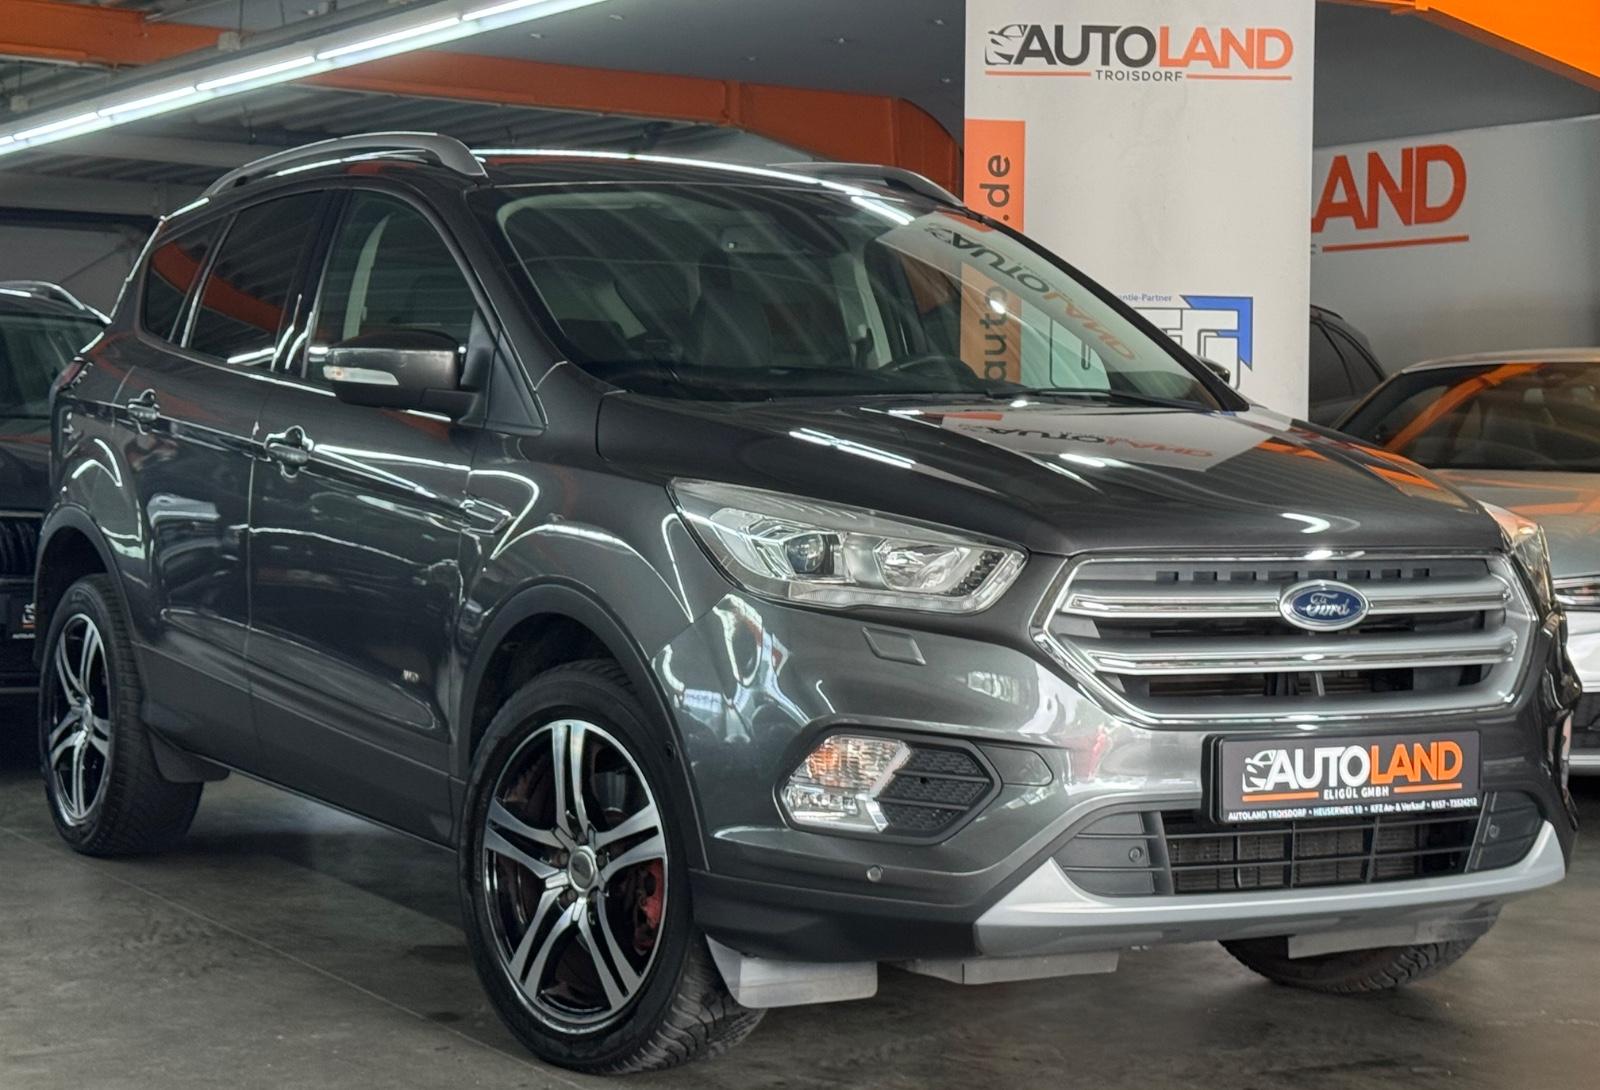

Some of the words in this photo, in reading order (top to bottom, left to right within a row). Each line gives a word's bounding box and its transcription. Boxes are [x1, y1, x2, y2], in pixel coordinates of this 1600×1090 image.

[1013, 24, 1294, 69] AUTOLAND
[1096, 69, 1183, 82] TROISDORF
[1311, 144, 1467, 233] AND
[1119, 292, 1172, 303] ntie-Partner
[1299, 592, 1350, 617] Ford
[1265, 740, 1463, 790] AUTOLAND
[1323, 786, 1359, 800] ELIGÜL
[1361, 786, 1390, 798] GMBH
[1228, 810, 1267, 821] AUTOLAND
[1268, 808, 1307, 819] TROISDORF
